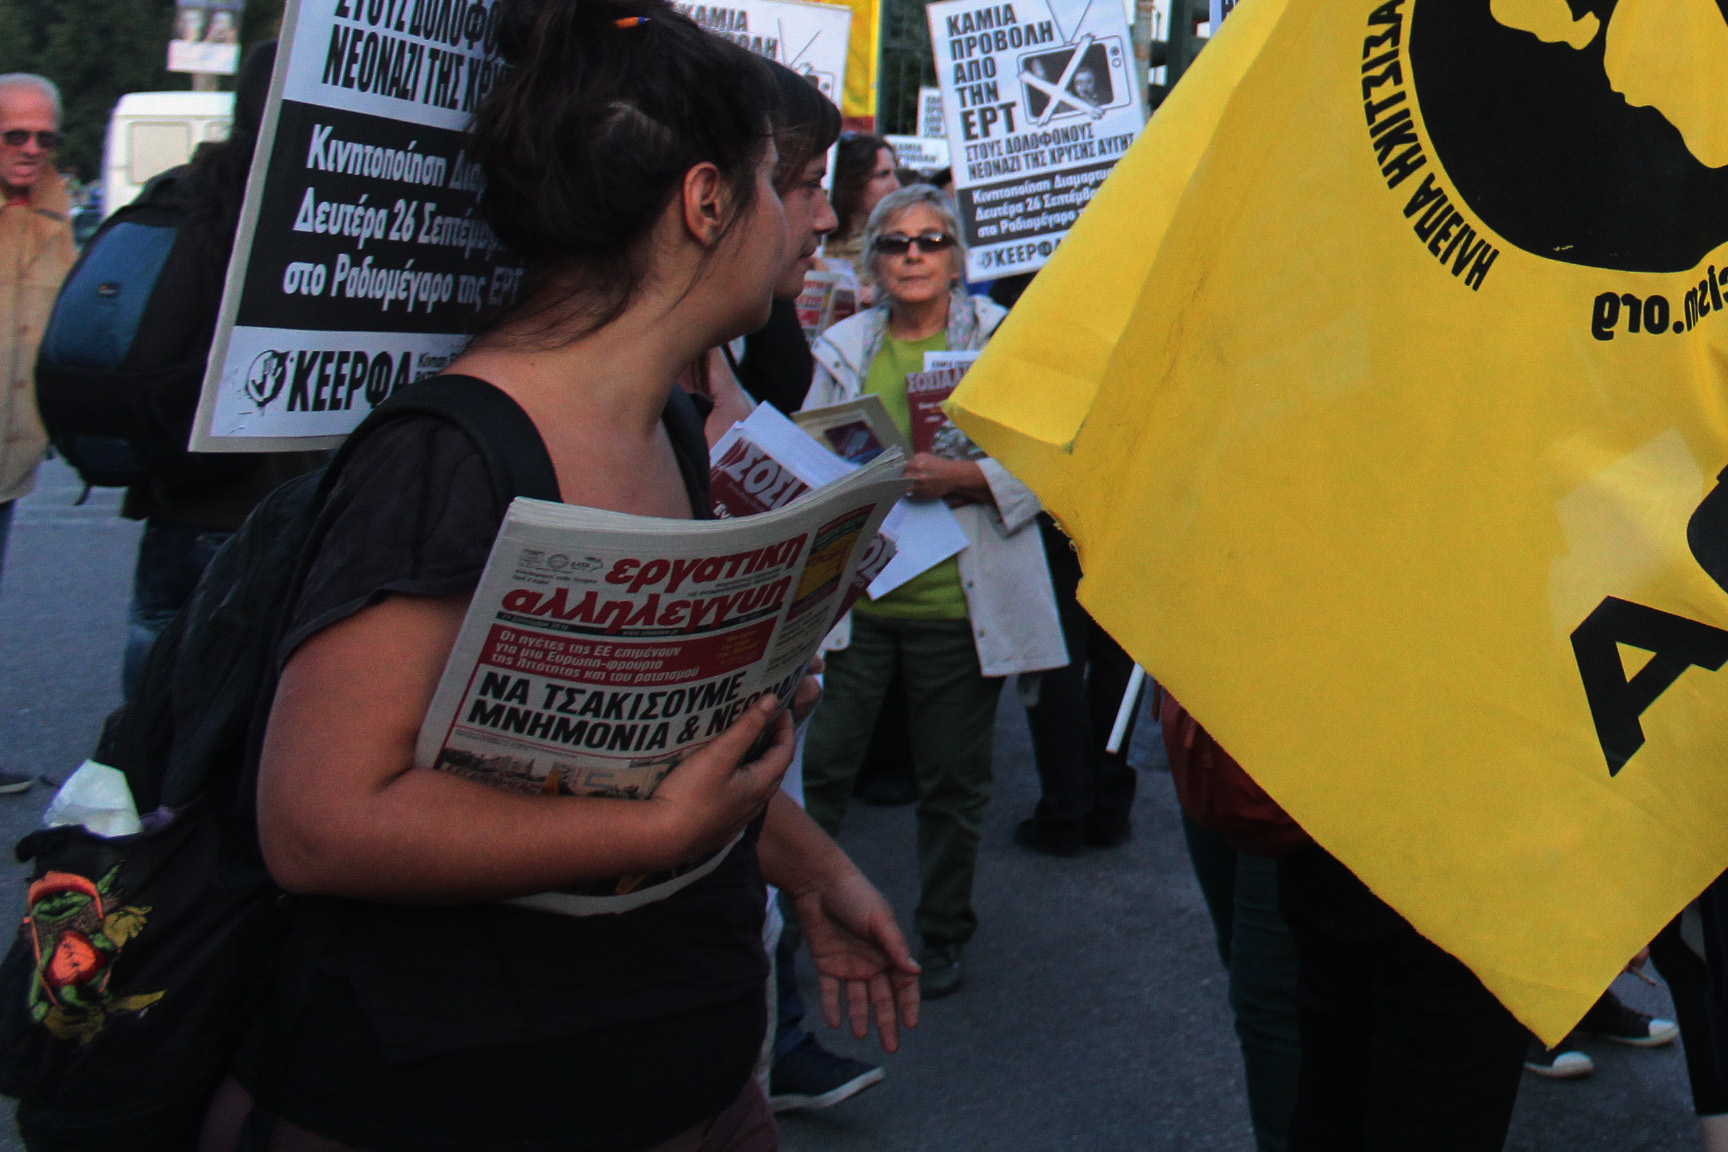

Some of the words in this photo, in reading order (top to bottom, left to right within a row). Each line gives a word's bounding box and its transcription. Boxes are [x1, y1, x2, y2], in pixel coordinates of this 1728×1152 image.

[946, 3, 1017, 37] ΚΑΜΙΑ
[949, 19, 1055, 61] ΠΡΟΒΟΛΗ
[321, 24, 426, 102] ΝΕΟΝΑΖΙ
[422, 47, 466, 111] ΤΗΣ
[953, 56, 998, 85] ΑΠΟ
[955, 80, 999, 108] ΤΗΝ
[959, 102, 1017, 141] ΕΡΤ
[306, 124, 447, 187] Κινητοποίηση
[966, 139, 1002, 163] ΣΤΟΥΣ
[967, 155, 1022, 181] ΝΕΟΝΑΖΙ
[1024, 151, 1049, 172] ΤΗΣ
[292, 187, 390, 250] Δευτέρα
[388, 199, 418, 242] 26
[1026, 196, 1043, 212] 26
[282, 261, 328, 297] στο
[330, 253, 455, 314] Ραδιομέγαρο
[457, 273, 488, 312] της
[604, 532, 809, 594] εργατικη
[501, 575, 793, 636] αλληλεγγυη
[593, 645, 613, 657] ΕΕ
[478, 671, 533, 706] ΝΑ
[542, 671, 748, 722] ΤΣΑΚΙΣΟΥΜΕ
[467, 698, 670, 751] ΜΝΗΜΟΝΙΑ
[675, 716, 701, 744] &
